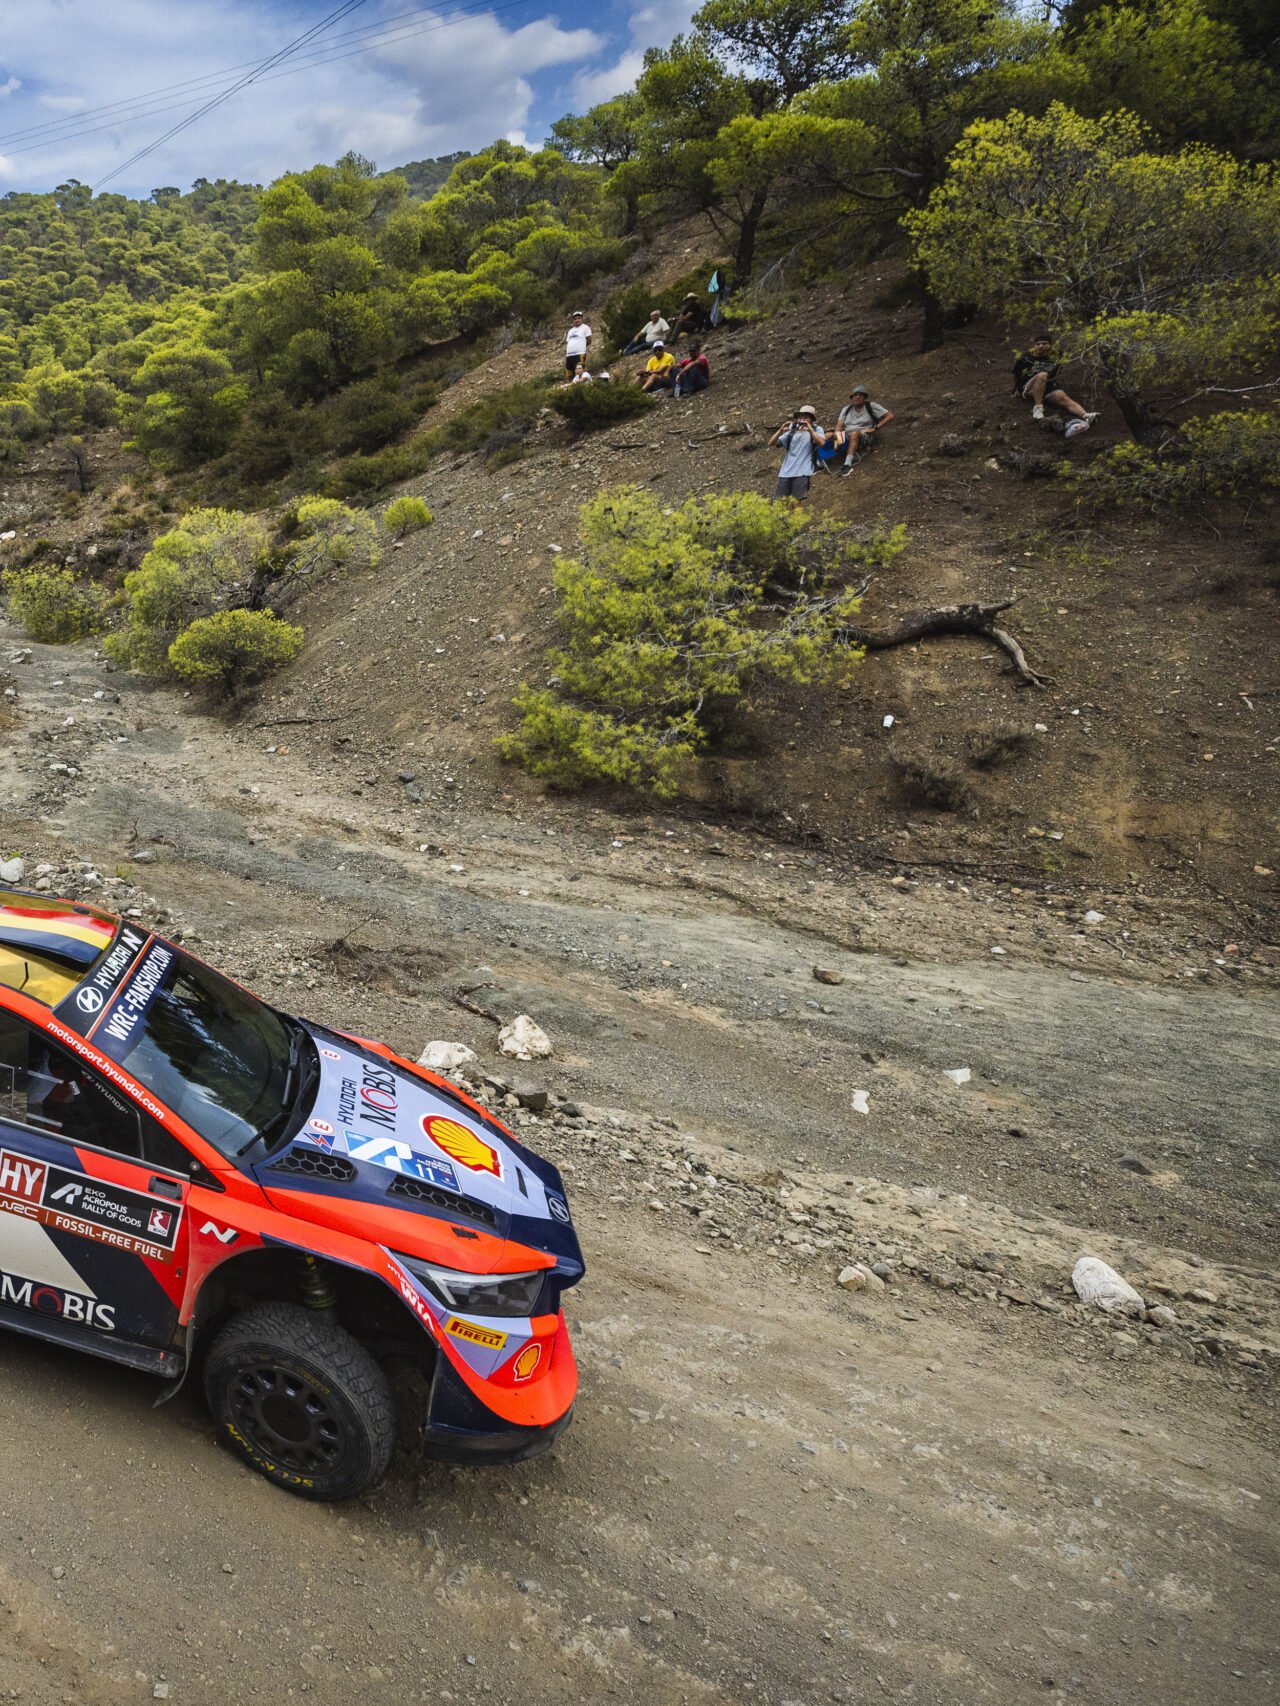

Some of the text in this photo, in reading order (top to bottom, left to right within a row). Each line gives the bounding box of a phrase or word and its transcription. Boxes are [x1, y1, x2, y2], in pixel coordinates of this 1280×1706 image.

[47, 1022, 165, 1120] motorsport.hyundai.com
[337, 1076, 357, 1126] HYUNDAI
[360, 1064, 398, 1132] MOBIS
[0, 1158, 43, 1196] HY
[415, 1163, 435, 1181] 11
[83, 1194, 127, 1214] ACROPOLIS
[84, 1187, 106, 1198] EKO
[82, 1202, 142, 1228] RALLY OF GODS
[55, 1216, 164, 1261] FOSSIL-FREE FUEL
[1, 1274, 116, 1331] MOBIS
[450, 1321, 503, 1346] PIRELLI
